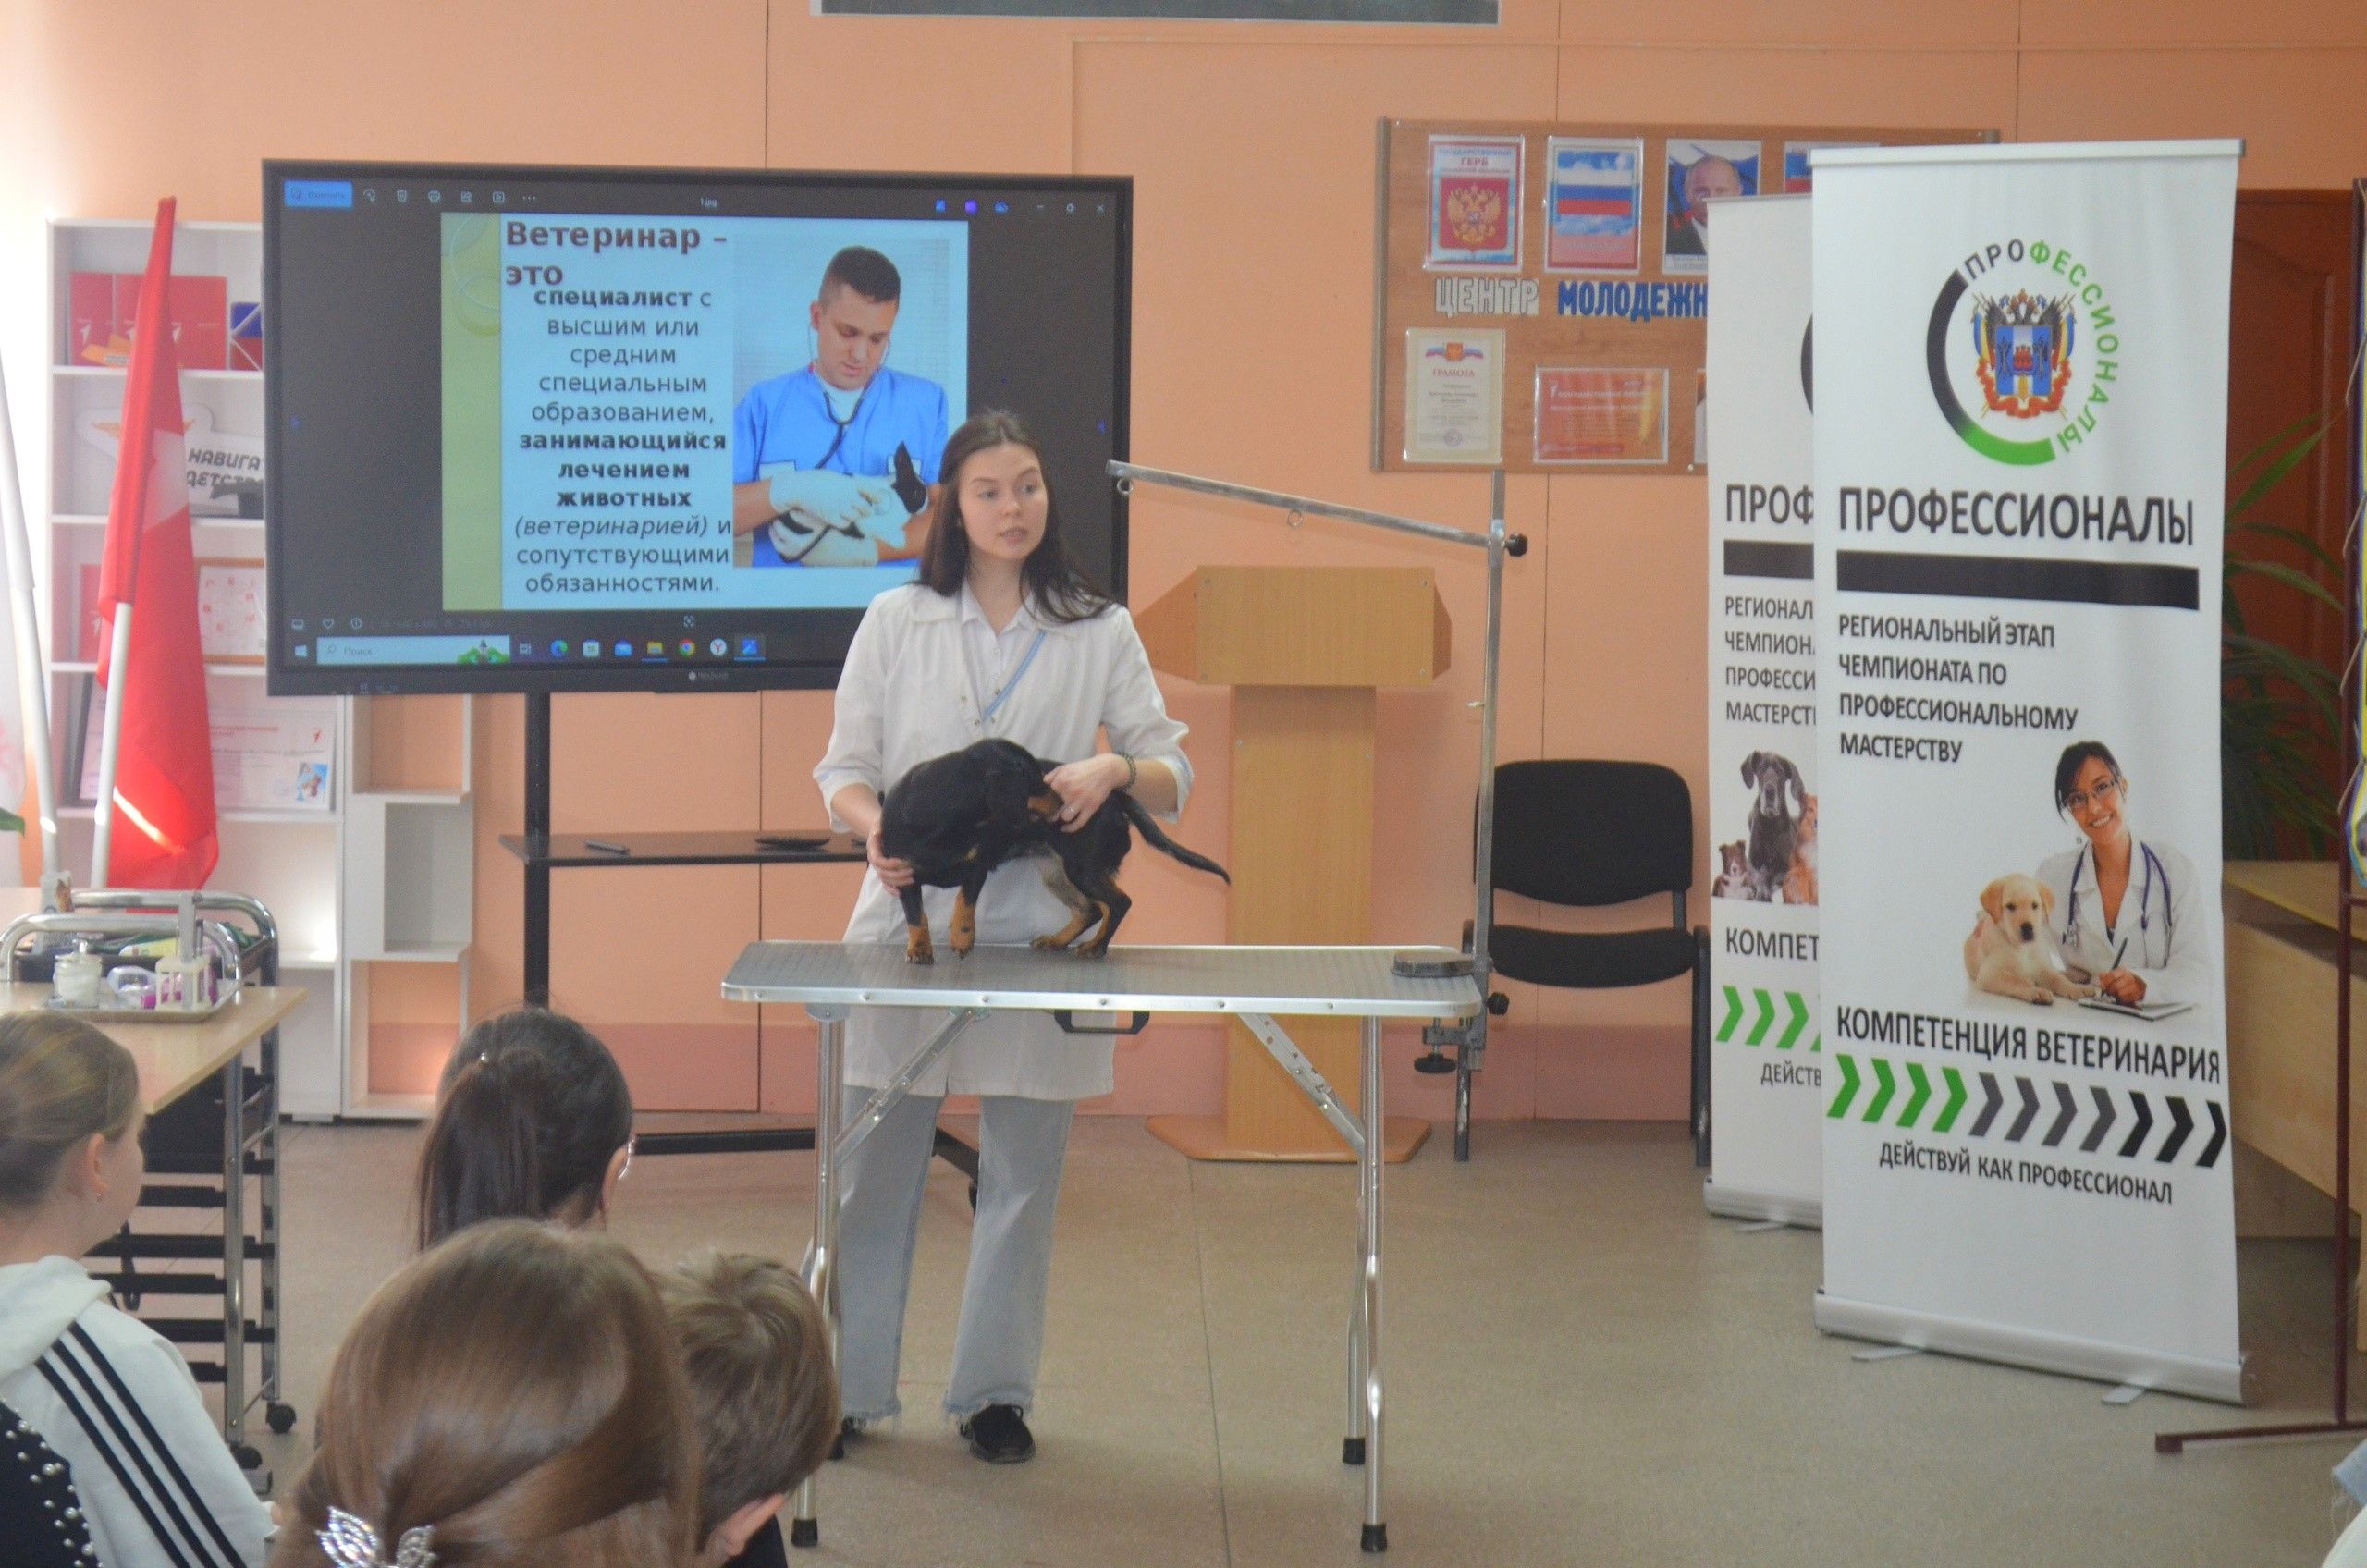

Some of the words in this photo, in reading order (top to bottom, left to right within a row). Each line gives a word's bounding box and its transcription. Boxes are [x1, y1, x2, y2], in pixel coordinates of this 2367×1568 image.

[1461, 157, 1489, 165] ГЕРБ
[506, 221, 701, 254] Ветеринар
[506, 265, 564, 285] это
[533, 290, 693, 308] специалист
[700, 292, 712, 307] с
[1435, 278, 1539, 316] ЦЕНТР
[1558, 280, 1708, 322] МОЛОДЕЖН
[547, 319, 646, 335] высшим
[656, 320, 699, 336] или
[1964, 239, 2118, 452] ПРОФЕССИОНАЛЫ
[570, 349, 676, 368] средним
[539, 376, 706, 394] специальным
[532, 402, 714, 425] образованием,
[520, 431, 726, 452] занимающийся
[188, 448, 261, 470] НАВИГА
[558, 462, 690, 478] лечением
[558, 492, 692, 507] животных
[1726, 484, 1813, 524] ПРОФ
[515, 516, 707, 539] (ветеринарией)
[718, 521, 731, 534] и
[1839, 487, 2193, 545] ПРОФЕССИОНАЛЫ
[517, 549, 729, 568] сопутствующими
[525, 573, 719, 593] обязанностями.
[1725, 596, 1813, 619] РЕГИОНАЛ
[1839, 614, 2002, 645] РЕГИОНАЛЬНЫЙ
[2006, 623, 2055, 647] ЭТАП
[1725, 631, 1815, 655] ЧЕМПИОН
[1726, 667, 1816, 690] ПРОФЕССИ
[1839, 654, 1972, 682] ЧЕМПИОНАТА
[1979, 662, 2006, 684] ПО
[1726, 701, 1816, 725] МАСТЕРСТ
[1839, 694, 2078, 730] ПРОФЕССИОНАЛЬНОМУ
[1839, 734, 1962, 763] МАСТЕРСТВУ
[1726, 927, 1819, 960] КОМПЕТ
[1837, 1006, 2026, 1061] КОМПЕТЕНЦИЯ
[2037, 1028, 2220, 1084] ВЕТЕРИНАРИЯ
[1880, 1141, 1970, 1175] ДЕЙСТВУЙ
[1978, 1156, 2013, 1180] КАК
[2019, 1161, 2173, 1204] ПРОФЕССИОНАЛ
